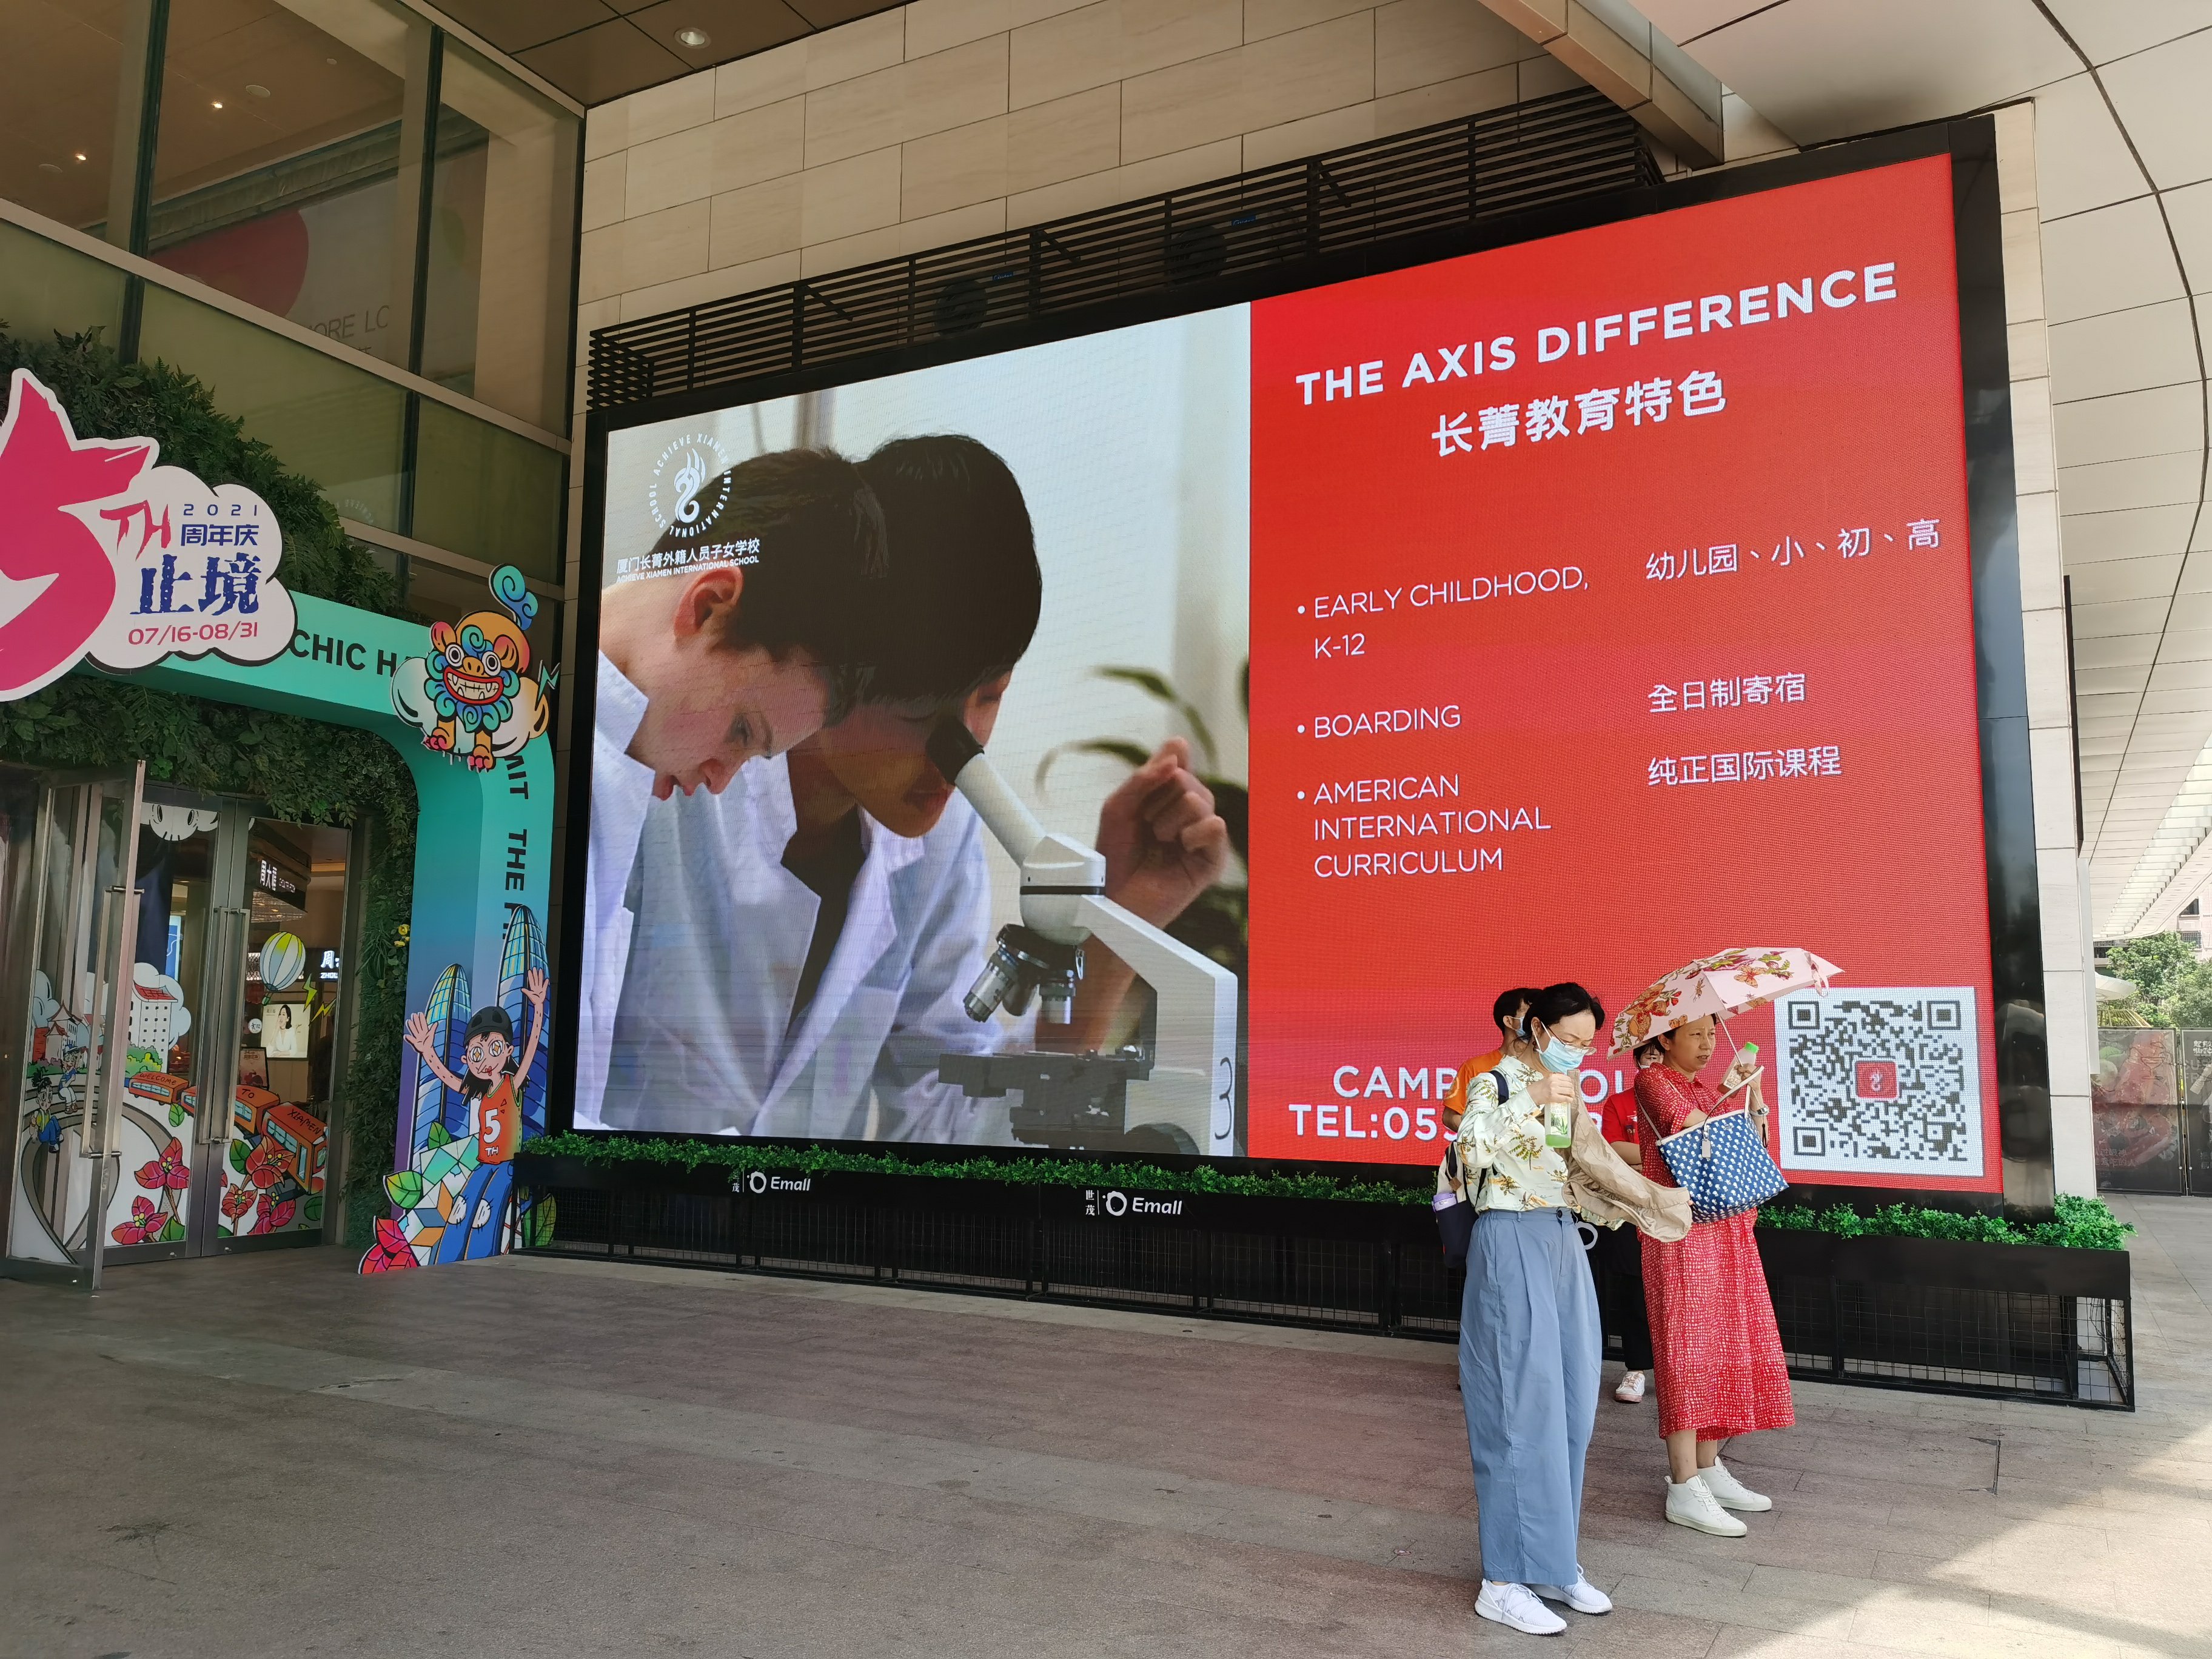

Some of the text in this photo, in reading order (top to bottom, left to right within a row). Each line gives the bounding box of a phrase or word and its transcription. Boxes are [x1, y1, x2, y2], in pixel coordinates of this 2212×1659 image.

[306, 314, 355, 338] ORE
[1296, 261, 1897, 405] THE AXIS DIFFERENCE
[1432, 369, 1726, 457] 长菁教育特色
[649, 433, 732, 538] ACHIEVE XIAMEN INTERNATIONAL SCHOOL
[183, 503, 257, 516] 2021
[181, 524, 259, 546] 周年庆
[616, 538, 760, 575] 厦门长菁外籍人员子女学校
[616, 555, 759, 583] ACHIEVE XIAMEN INTERNATIONAL SCHOOL
[130, 552, 261, 615] 止境
[1315, 566, 1589, 618] EARLY CHILDHOOD,
[128, 620, 258, 646] 07/16-08/31
[289, 629, 366, 671] CHIC
[1315, 632, 1366, 659] K-12
[1647, 672, 1806, 714] 全日制寄宿
[1315, 705, 1461, 739] BOARDING
[1647, 745, 1843, 786] 纯正国际课程
[1313, 773, 1459, 805] AMERICAN
[1315, 806, 1552, 841] INTERNATIONAL
[505, 828, 528, 891] THE
[1314, 847, 1503, 877] CURRICULUM
[1333, 1065, 1458, 1100] CAMP
[139, 1073, 321, 1135] WELCOME TO XIAMEN
[483, 1108, 501, 1144] 5
[1289, 1104, 1458, 1142] TEL:05
[484, 1145, 498, 1157] TH
[771, 1176, 811, 1191] Emall
[1085, 1190, 1095, 1216] 世茂
[1132, 1197, 1182, 1215] Emall
